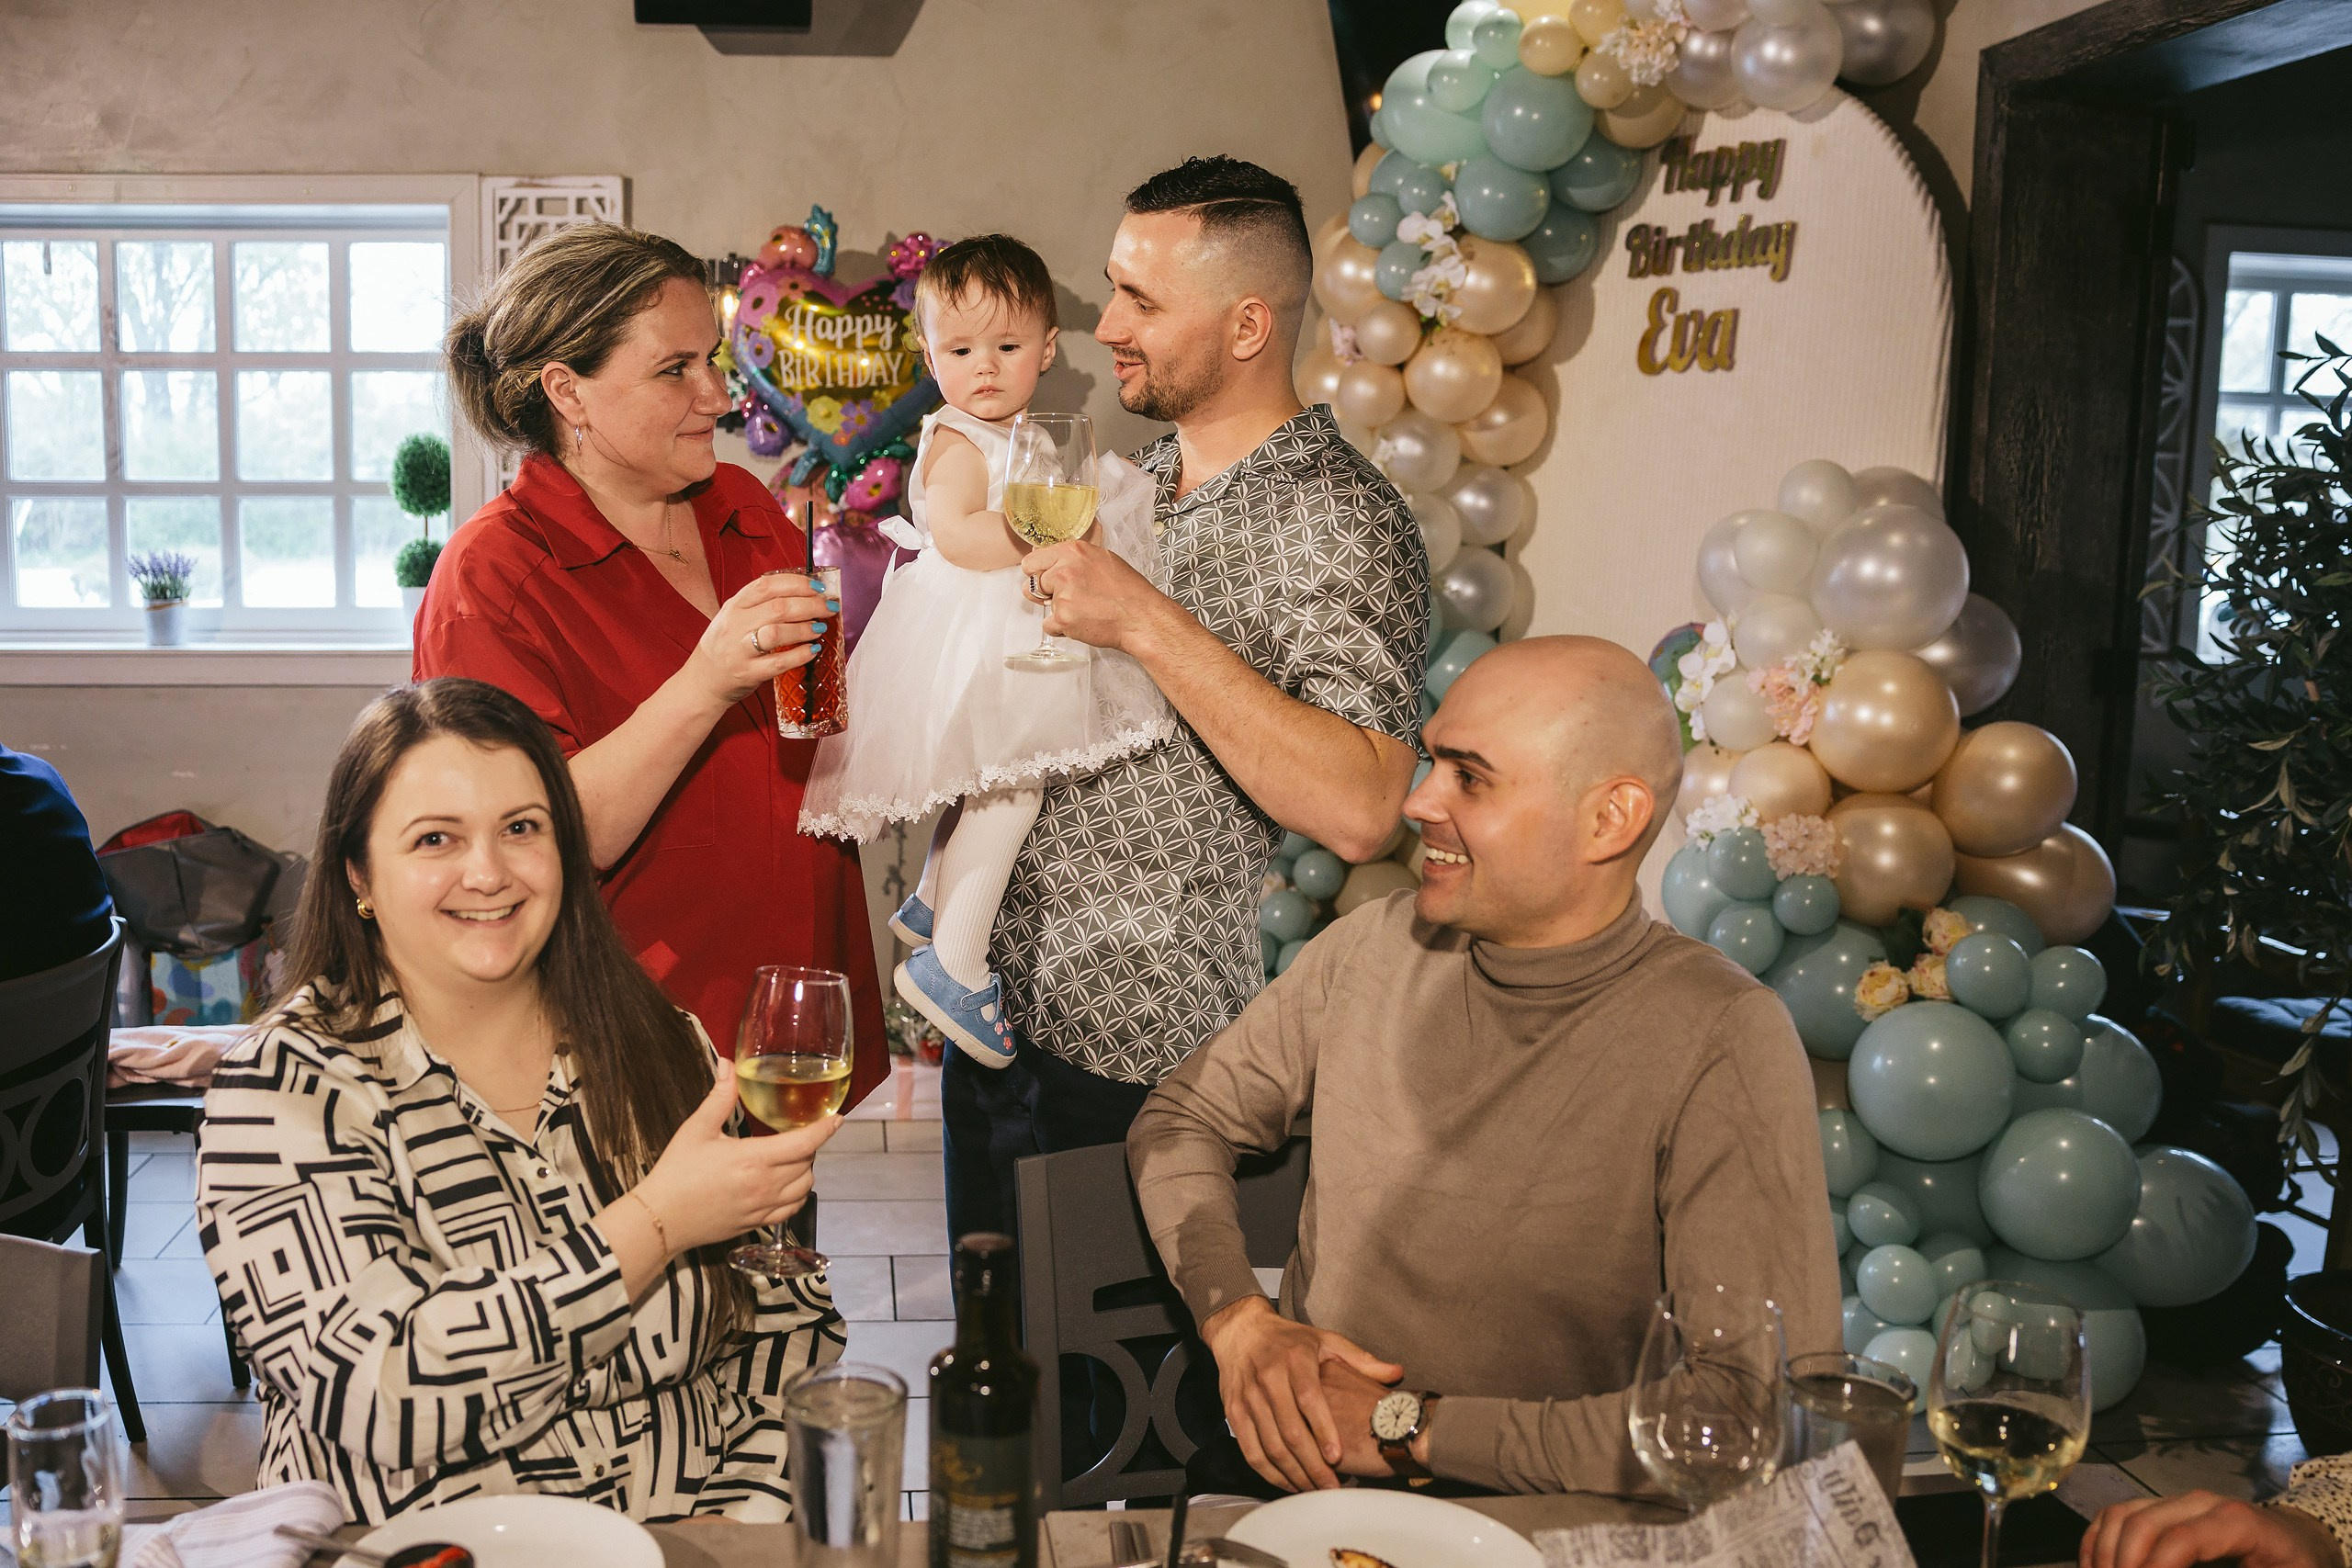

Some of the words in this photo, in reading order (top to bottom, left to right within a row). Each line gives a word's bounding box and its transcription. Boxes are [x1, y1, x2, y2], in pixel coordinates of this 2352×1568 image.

[1660, 135, 1787, 207] Happy
[1625, 214, 1798, 282] Birthday
[782, 303, 898, 351] Happy
[1637, 287, 1739, 376] Eva
